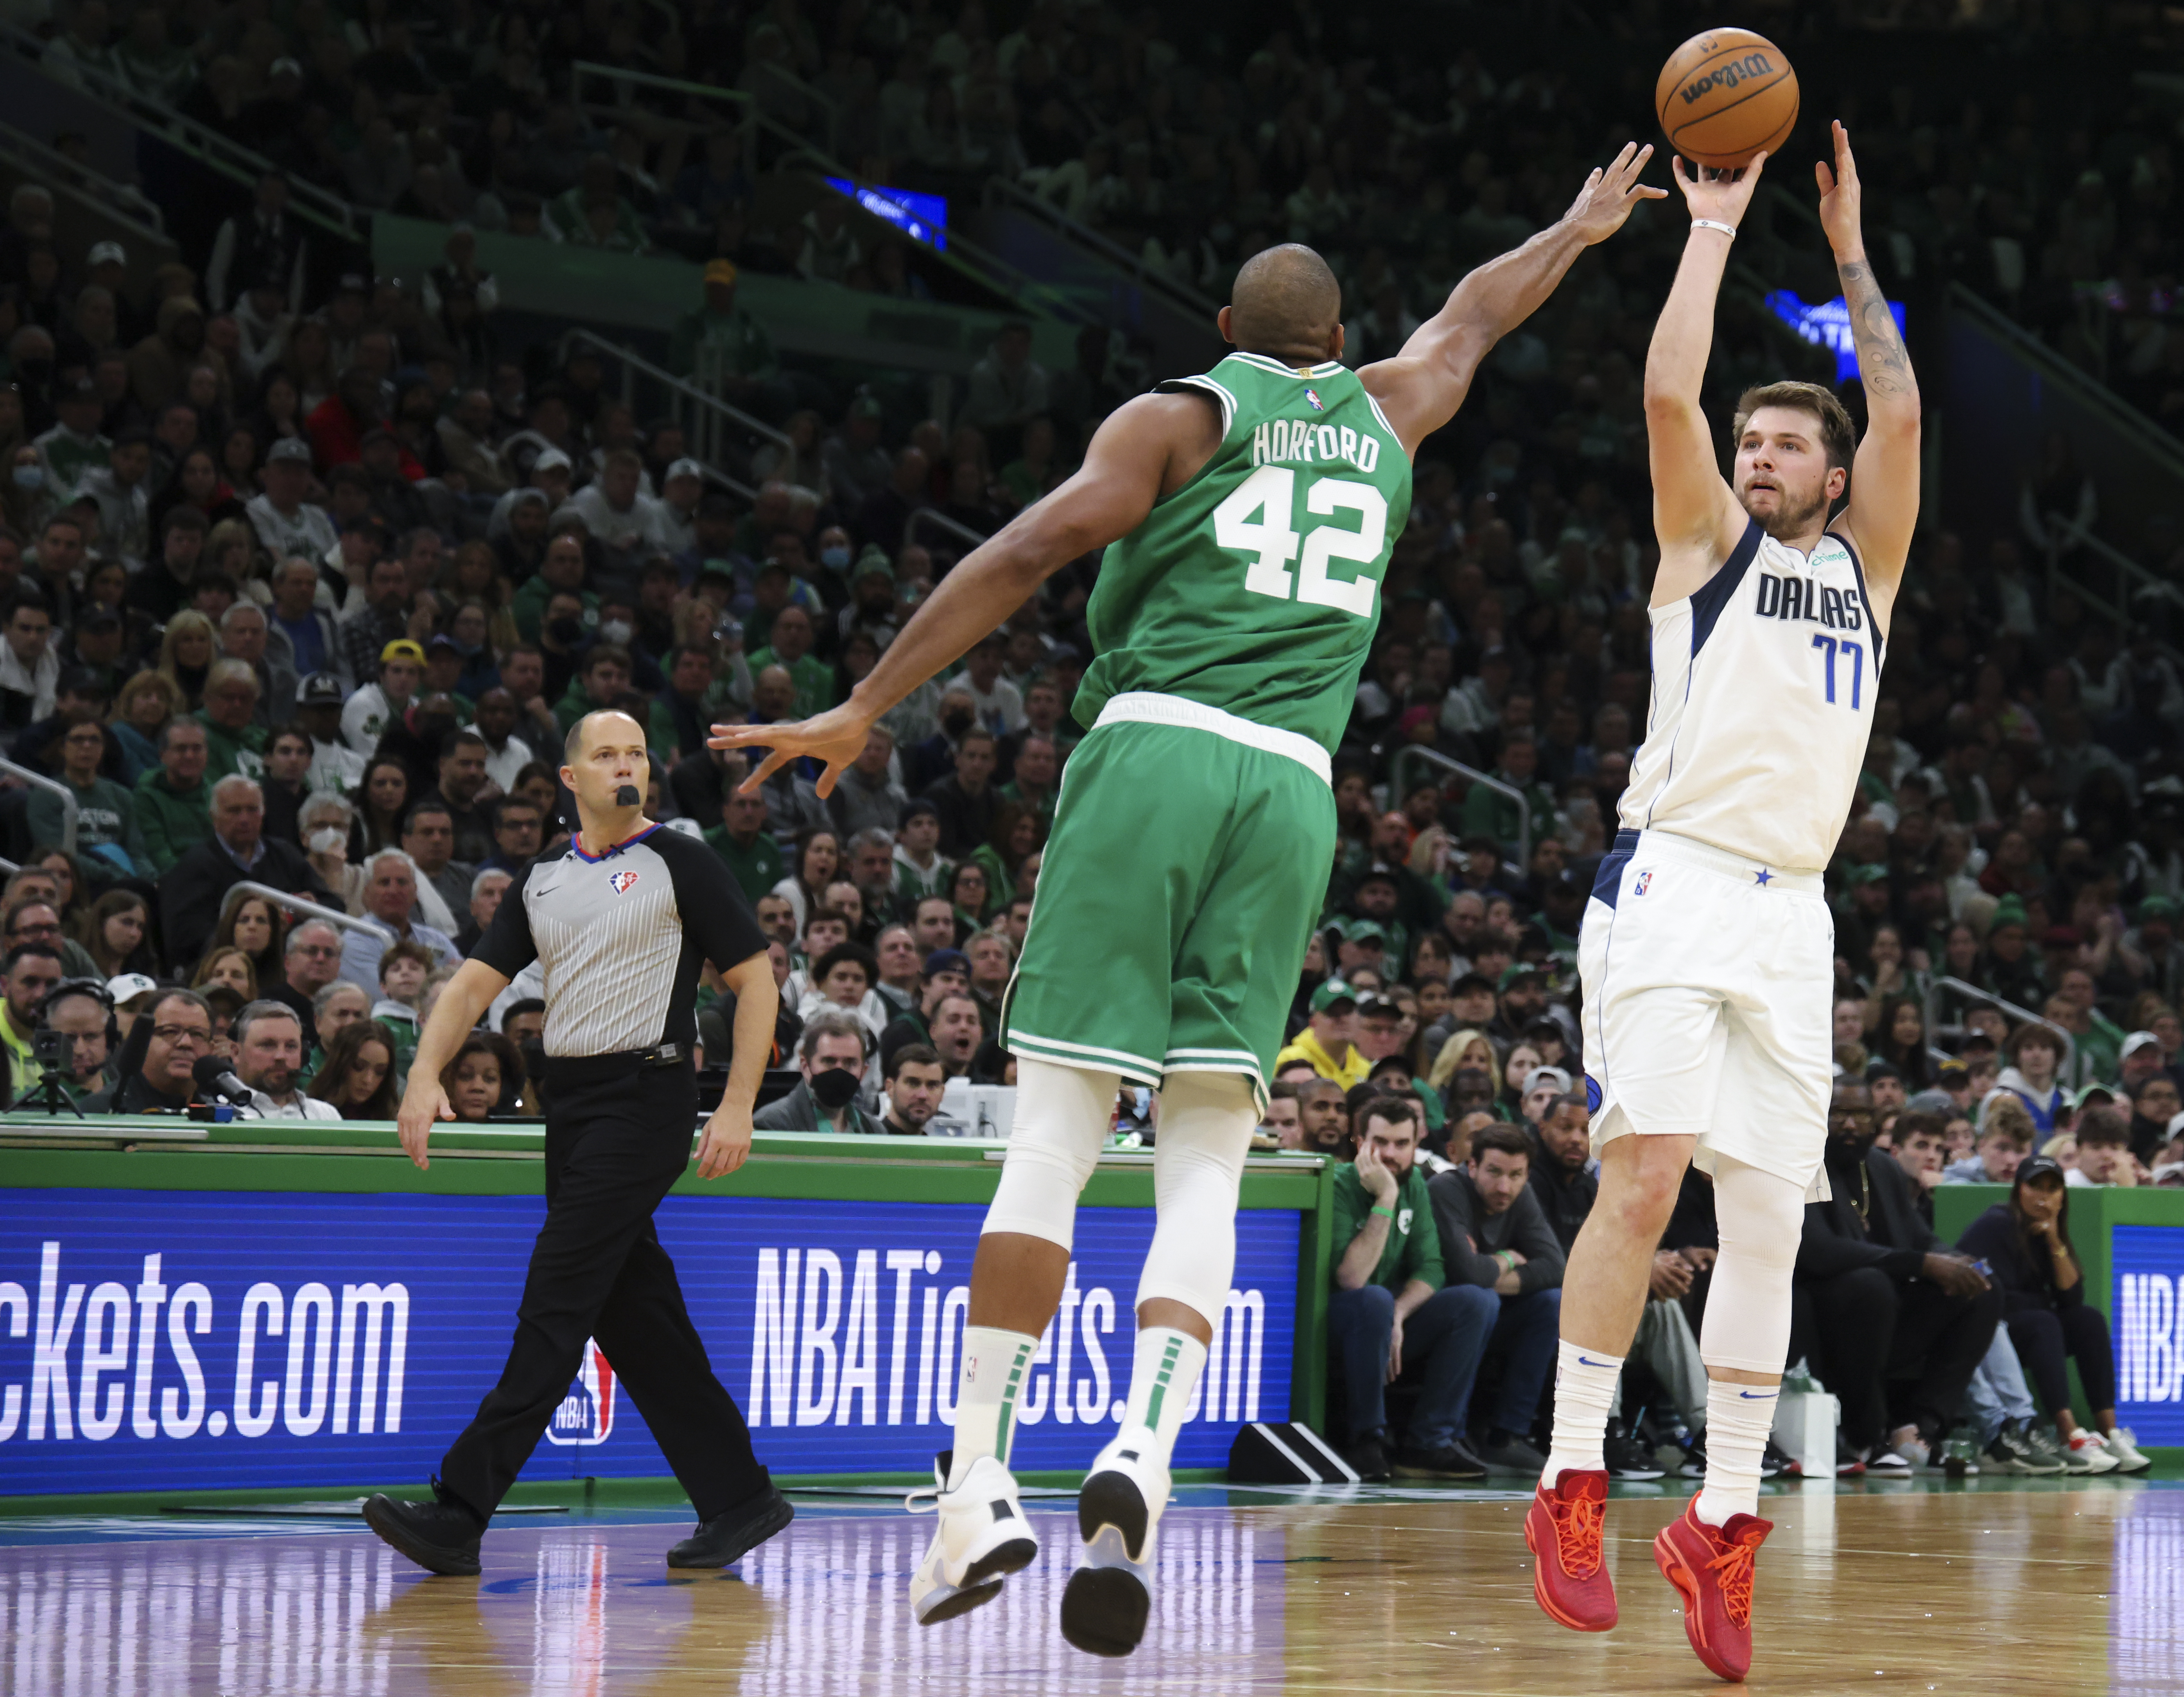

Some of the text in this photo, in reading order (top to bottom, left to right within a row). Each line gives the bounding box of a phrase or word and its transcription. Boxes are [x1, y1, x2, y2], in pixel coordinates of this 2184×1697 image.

[1680, 53, 1774, 105] Wilson
[1253, 419, 1380, 473] HORFORD
[1213, 464, 1388, 618] 42
[1812, 551, 1849, 566] chime
[1755, 572, 1863, 632] DALLAS
[1811, 633, 1863, 712] 77
[555, 1396, 588, 1429] NBA
